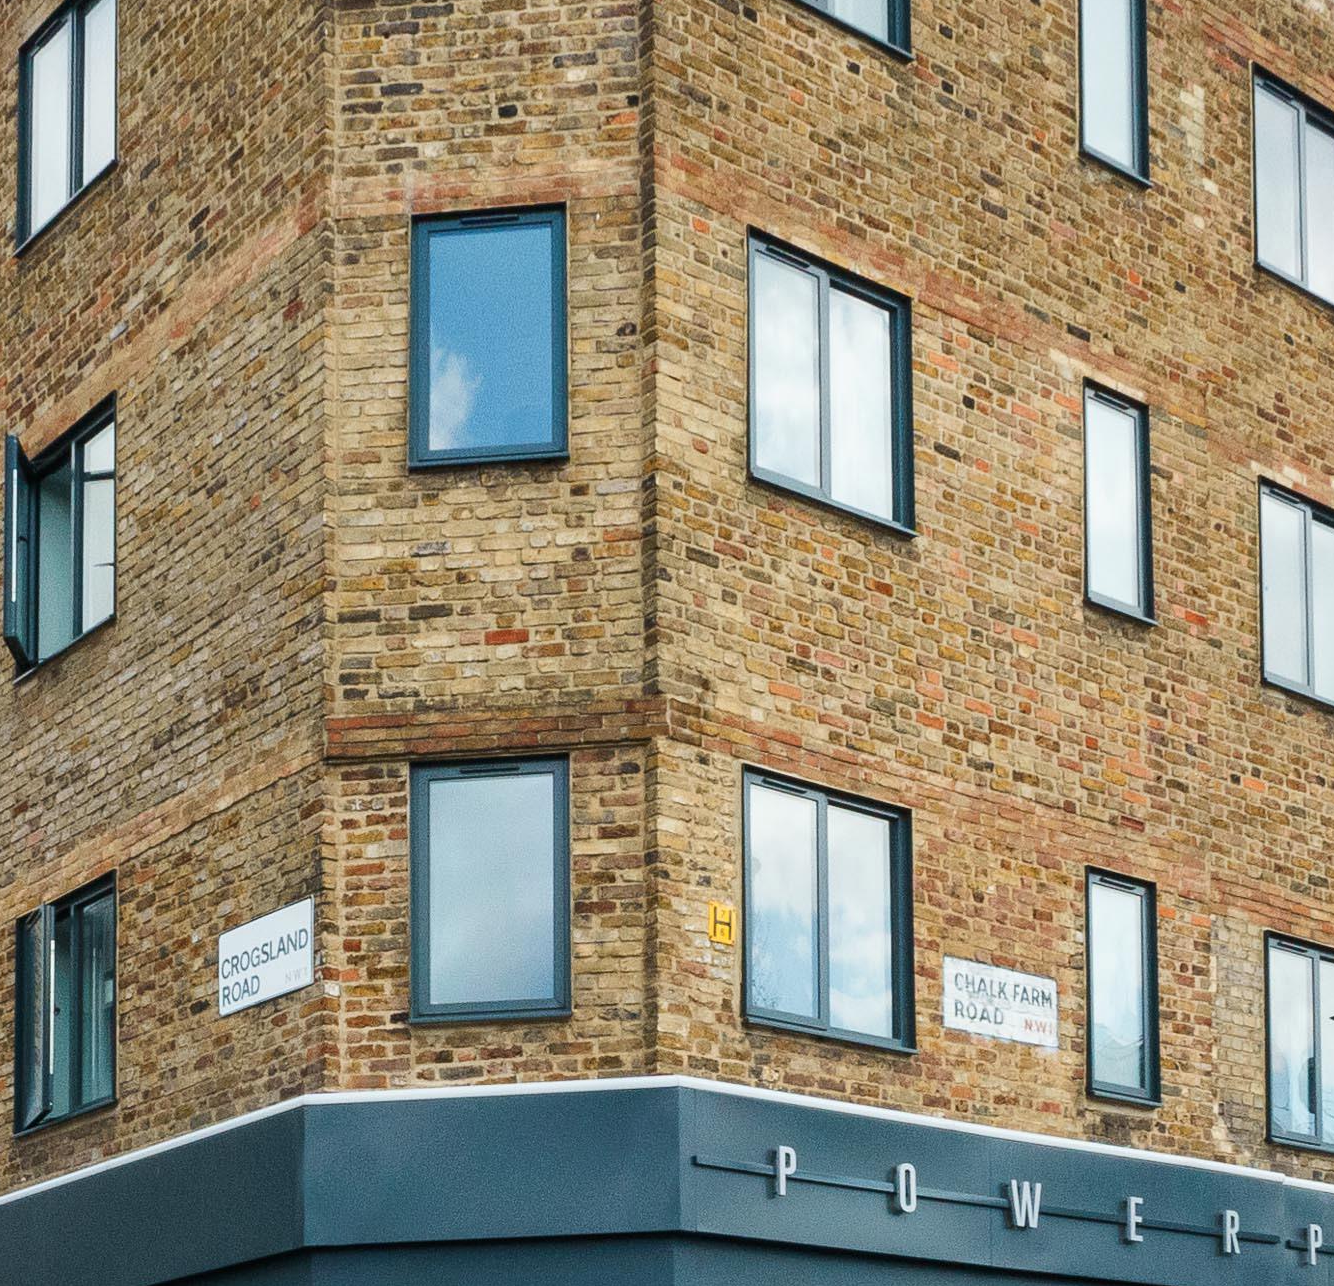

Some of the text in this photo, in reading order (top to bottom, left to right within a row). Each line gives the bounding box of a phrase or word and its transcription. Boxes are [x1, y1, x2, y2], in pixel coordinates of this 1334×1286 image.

[713, 906, 732, 940] H
[221, 928, 309, 979] CROGSLAND
[222, 975, 261, 1006] ROAD
[954, 972, 1052, 1008] CHALK FARM
[954, 999, 1004, 1025] ROAD
